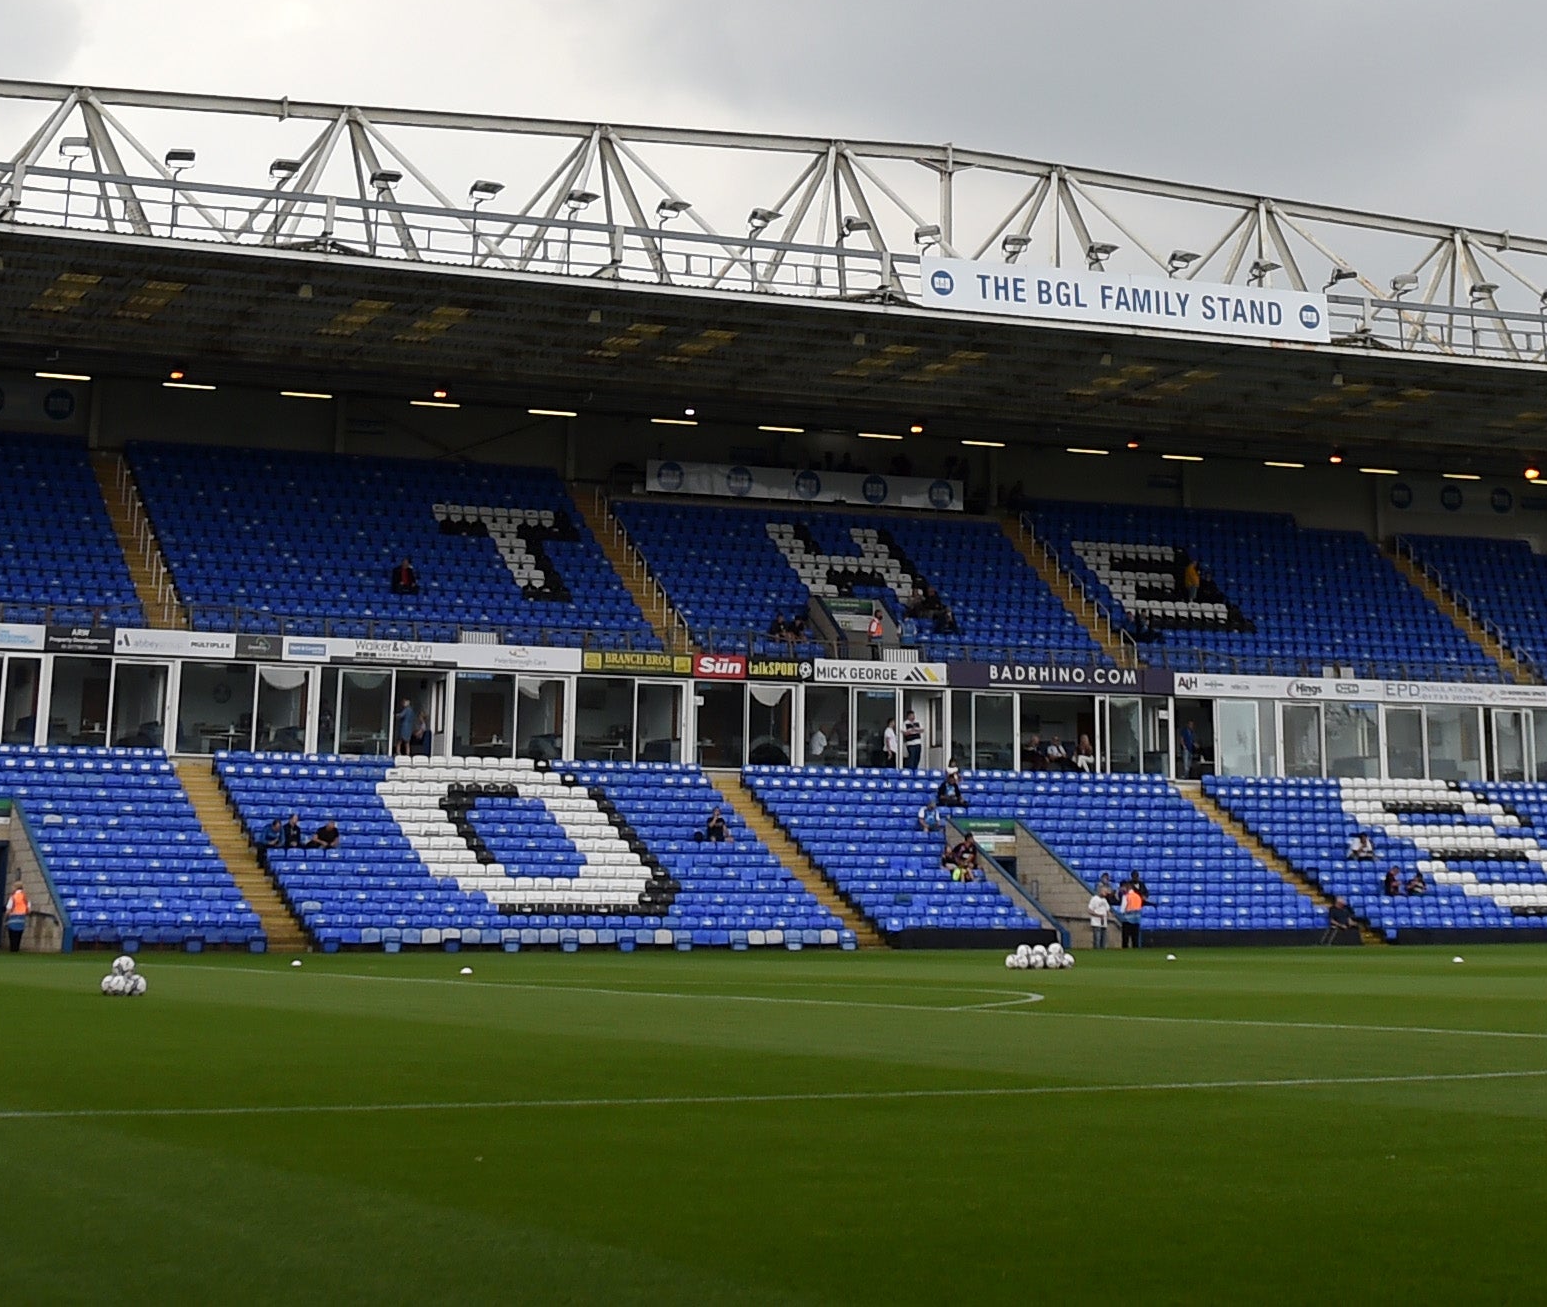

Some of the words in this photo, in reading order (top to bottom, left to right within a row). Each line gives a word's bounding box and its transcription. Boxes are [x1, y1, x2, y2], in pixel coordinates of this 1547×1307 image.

[977, 274, 1026, 303] THE
[1038, 279, 1088, 308] BGL
[1100, 285, 1190, 317] FAMILY
[1201, 295, 1282, 326] STAND
[604, 653, 644, 666] BRANCH
[646, 655, 671, 667] BROS
[748, 661, 799, 677] talkSPORT
[816, 665, 848, 680] MICK
[849, 666, 898, 681] GEORGE
[989, 664, 1137, 685] BADRHINO.COM
[1385, 682, 1421, 698] EPD
